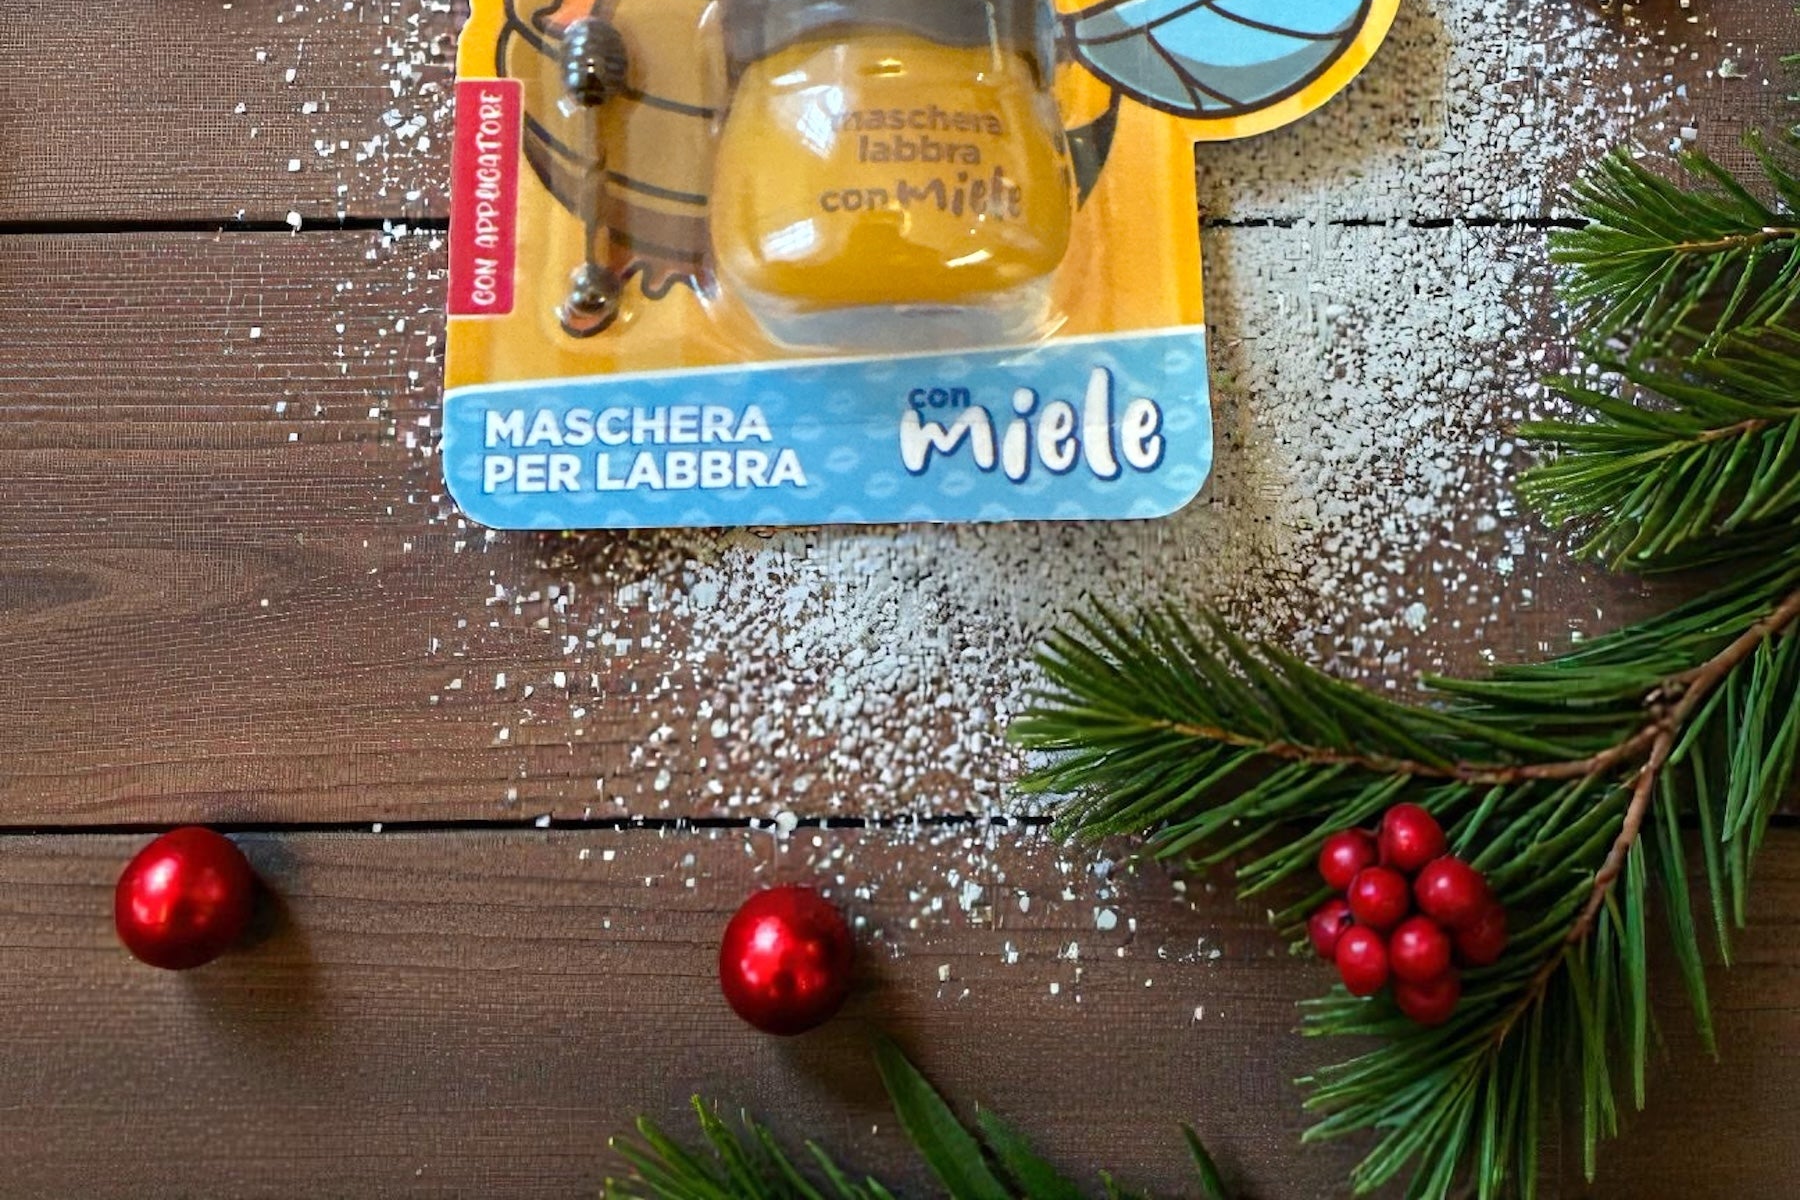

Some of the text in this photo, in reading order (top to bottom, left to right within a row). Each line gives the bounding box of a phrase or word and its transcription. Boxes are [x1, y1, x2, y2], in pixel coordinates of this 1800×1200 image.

[858, 135, 981, 164] labbra
[471, 90, 504, 306] CON APPLICATORE
[820, 188, 888, 212] con
[907, 387, 971, 409] con
[484, 405, 773, 448] MASCHERA
[483, 448, 808, 493] PER LABBRA
